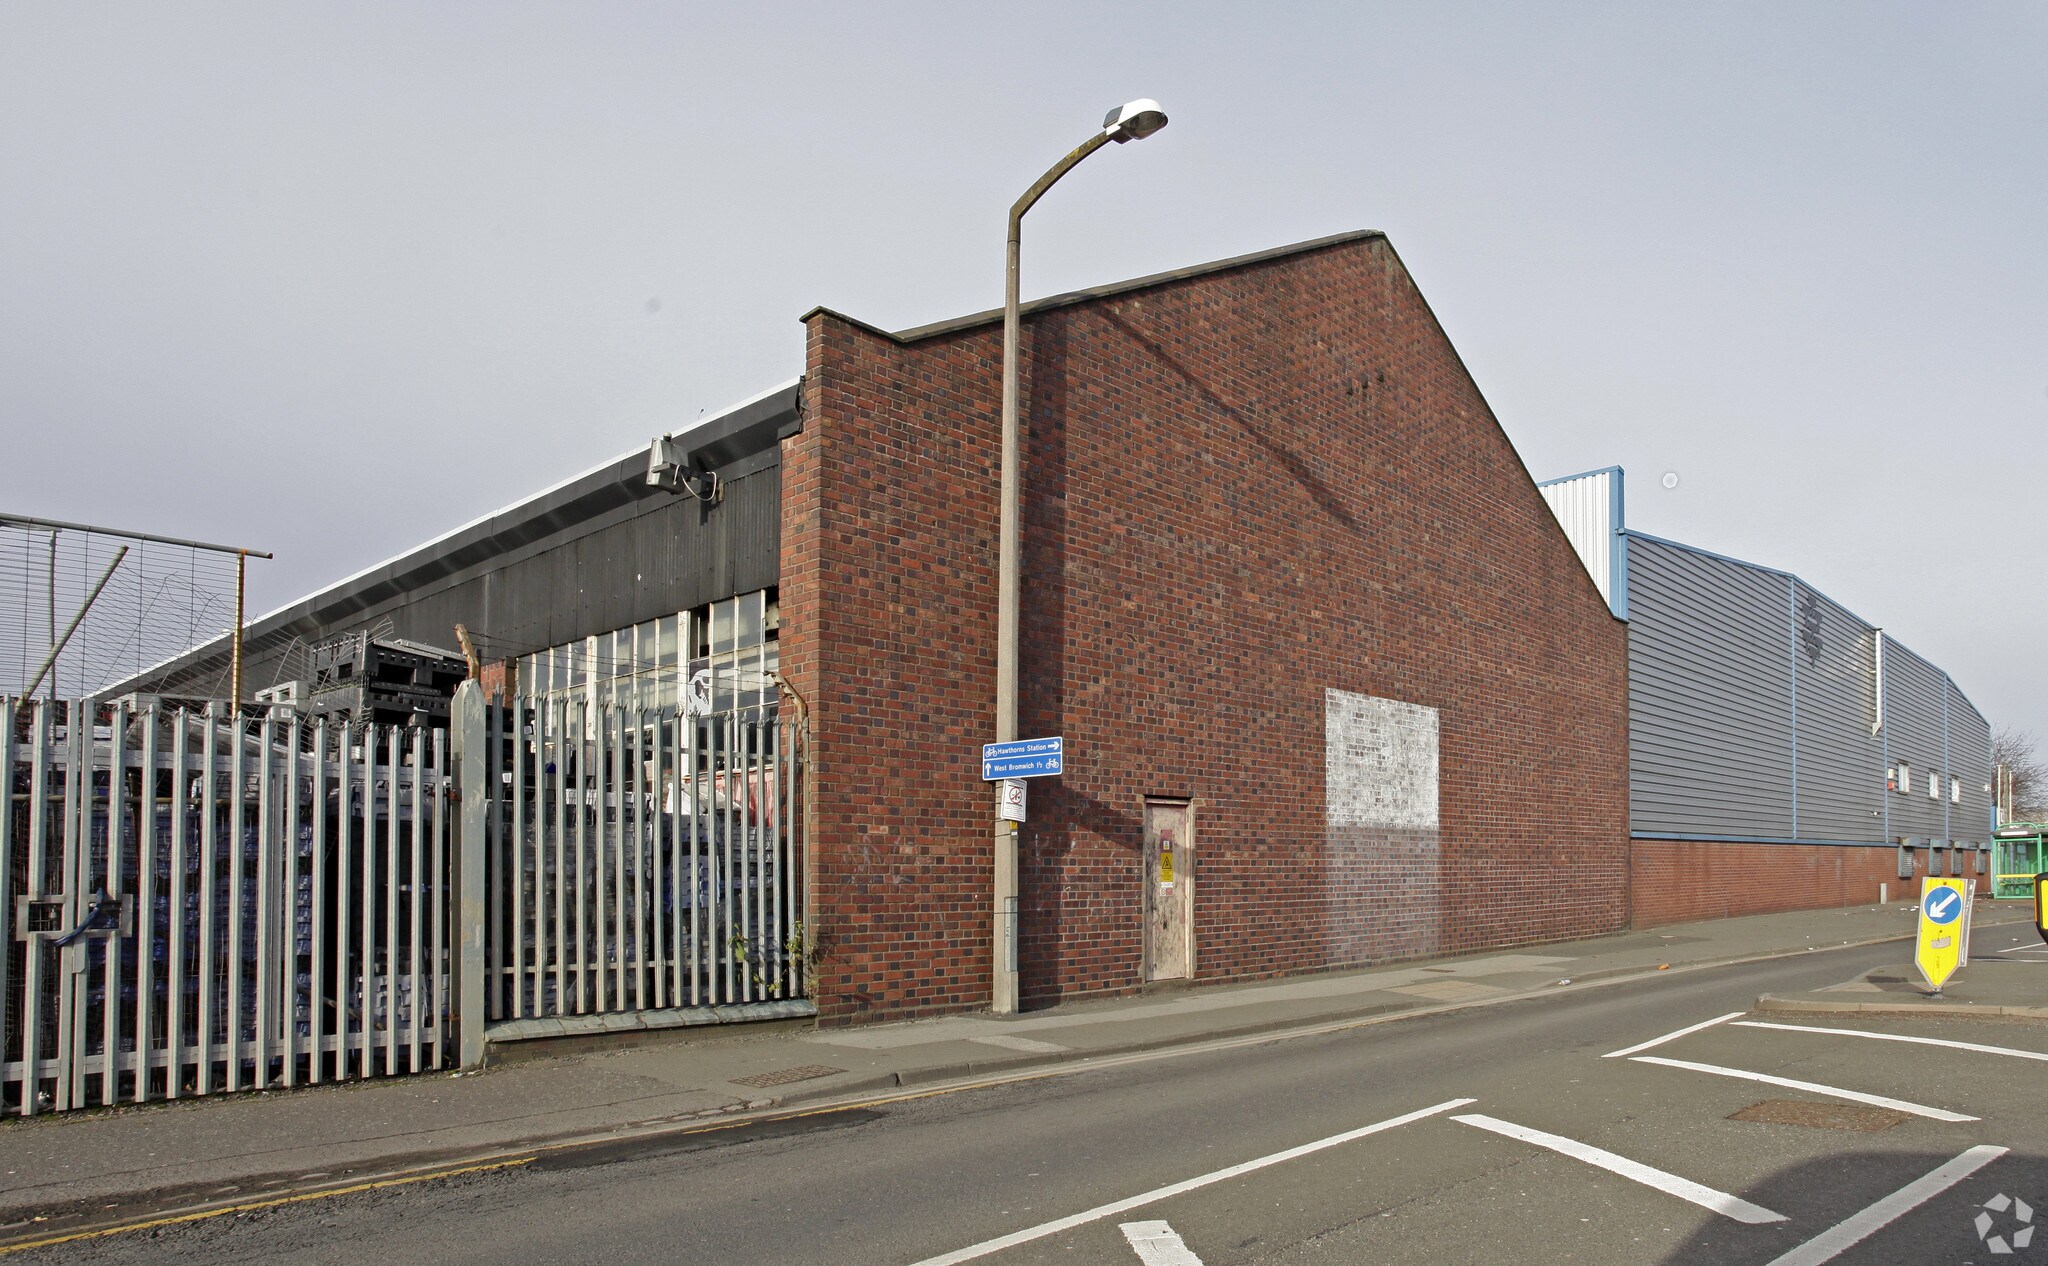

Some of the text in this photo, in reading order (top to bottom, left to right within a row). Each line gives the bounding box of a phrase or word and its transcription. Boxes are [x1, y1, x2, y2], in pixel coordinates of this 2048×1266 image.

[997, 744, 1046, 755] Hawthorns Station
[994, 764, 1007, 772] West
[1008, 762, 1034, 770] Bromwich
